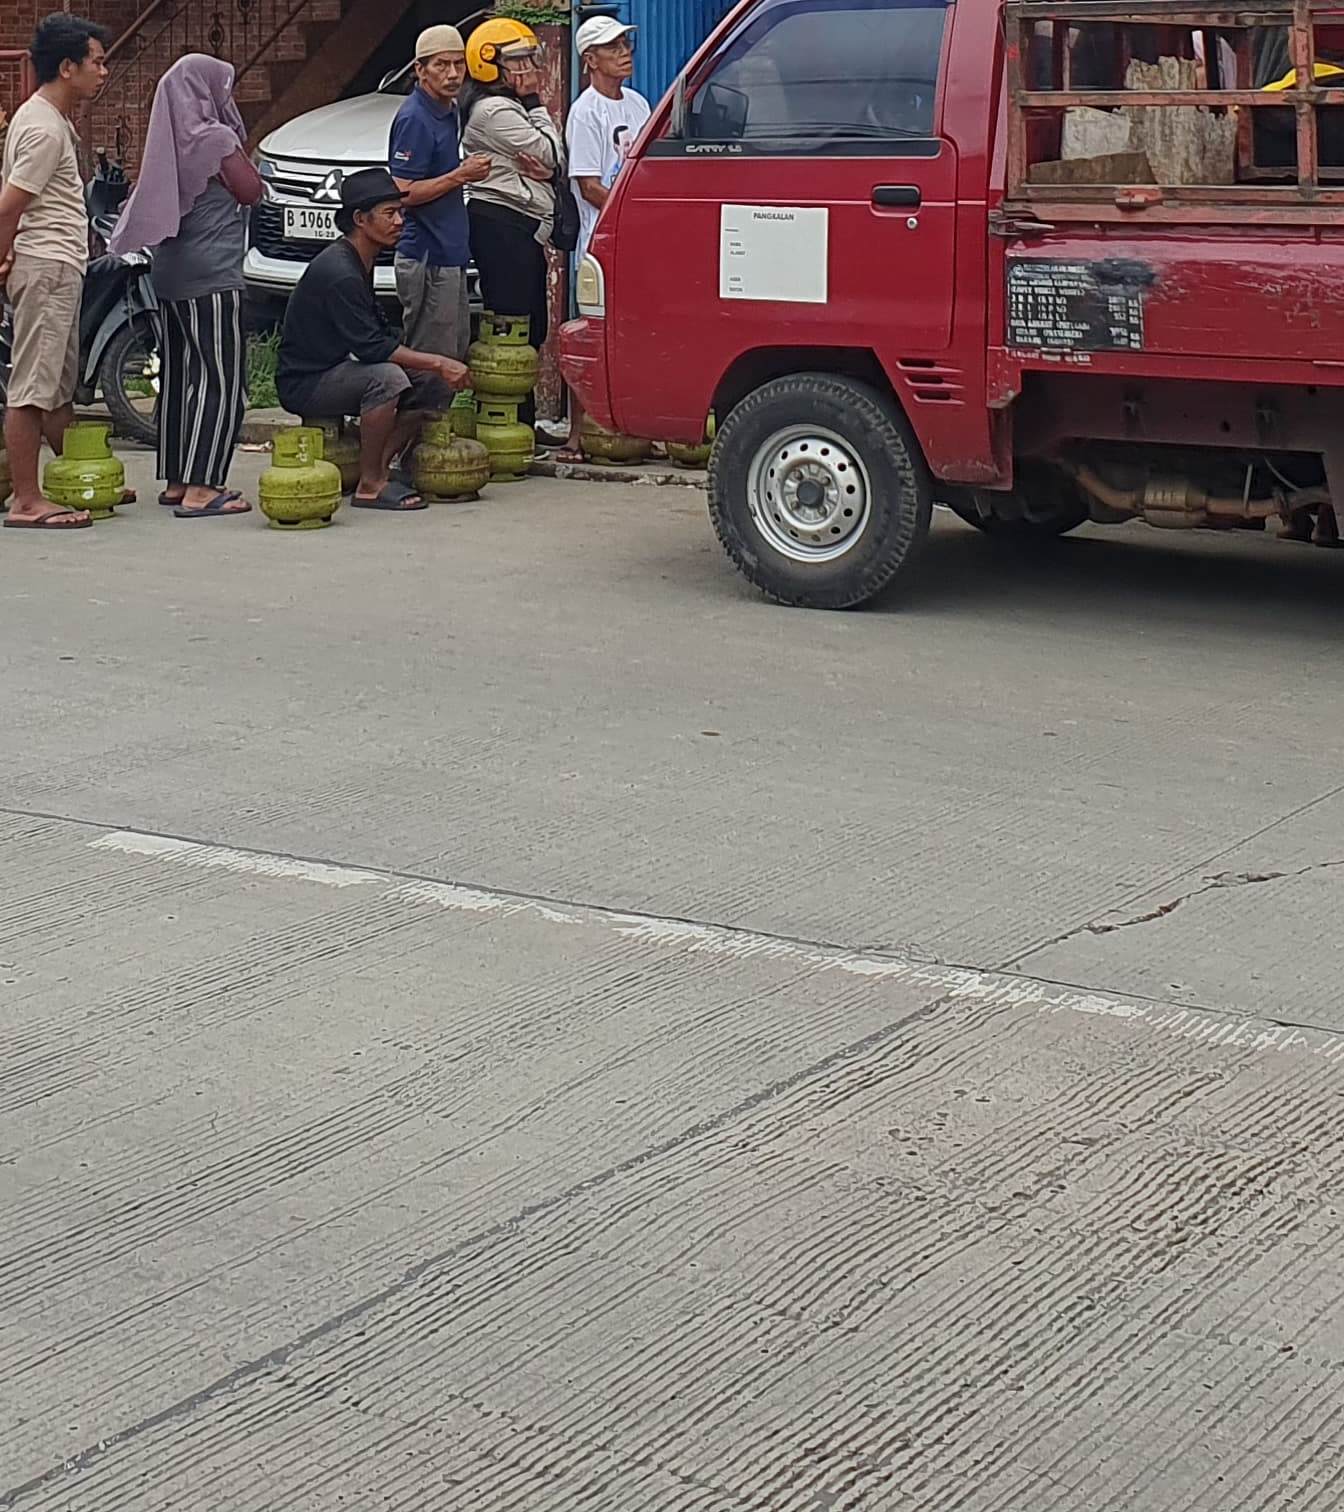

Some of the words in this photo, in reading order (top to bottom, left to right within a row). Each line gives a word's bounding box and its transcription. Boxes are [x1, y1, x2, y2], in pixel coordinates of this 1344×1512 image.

[287, 209, 295, 227] B
[300, 210, 332, 230] 1966
[752, 211, 795, 222] PANGKALAN
